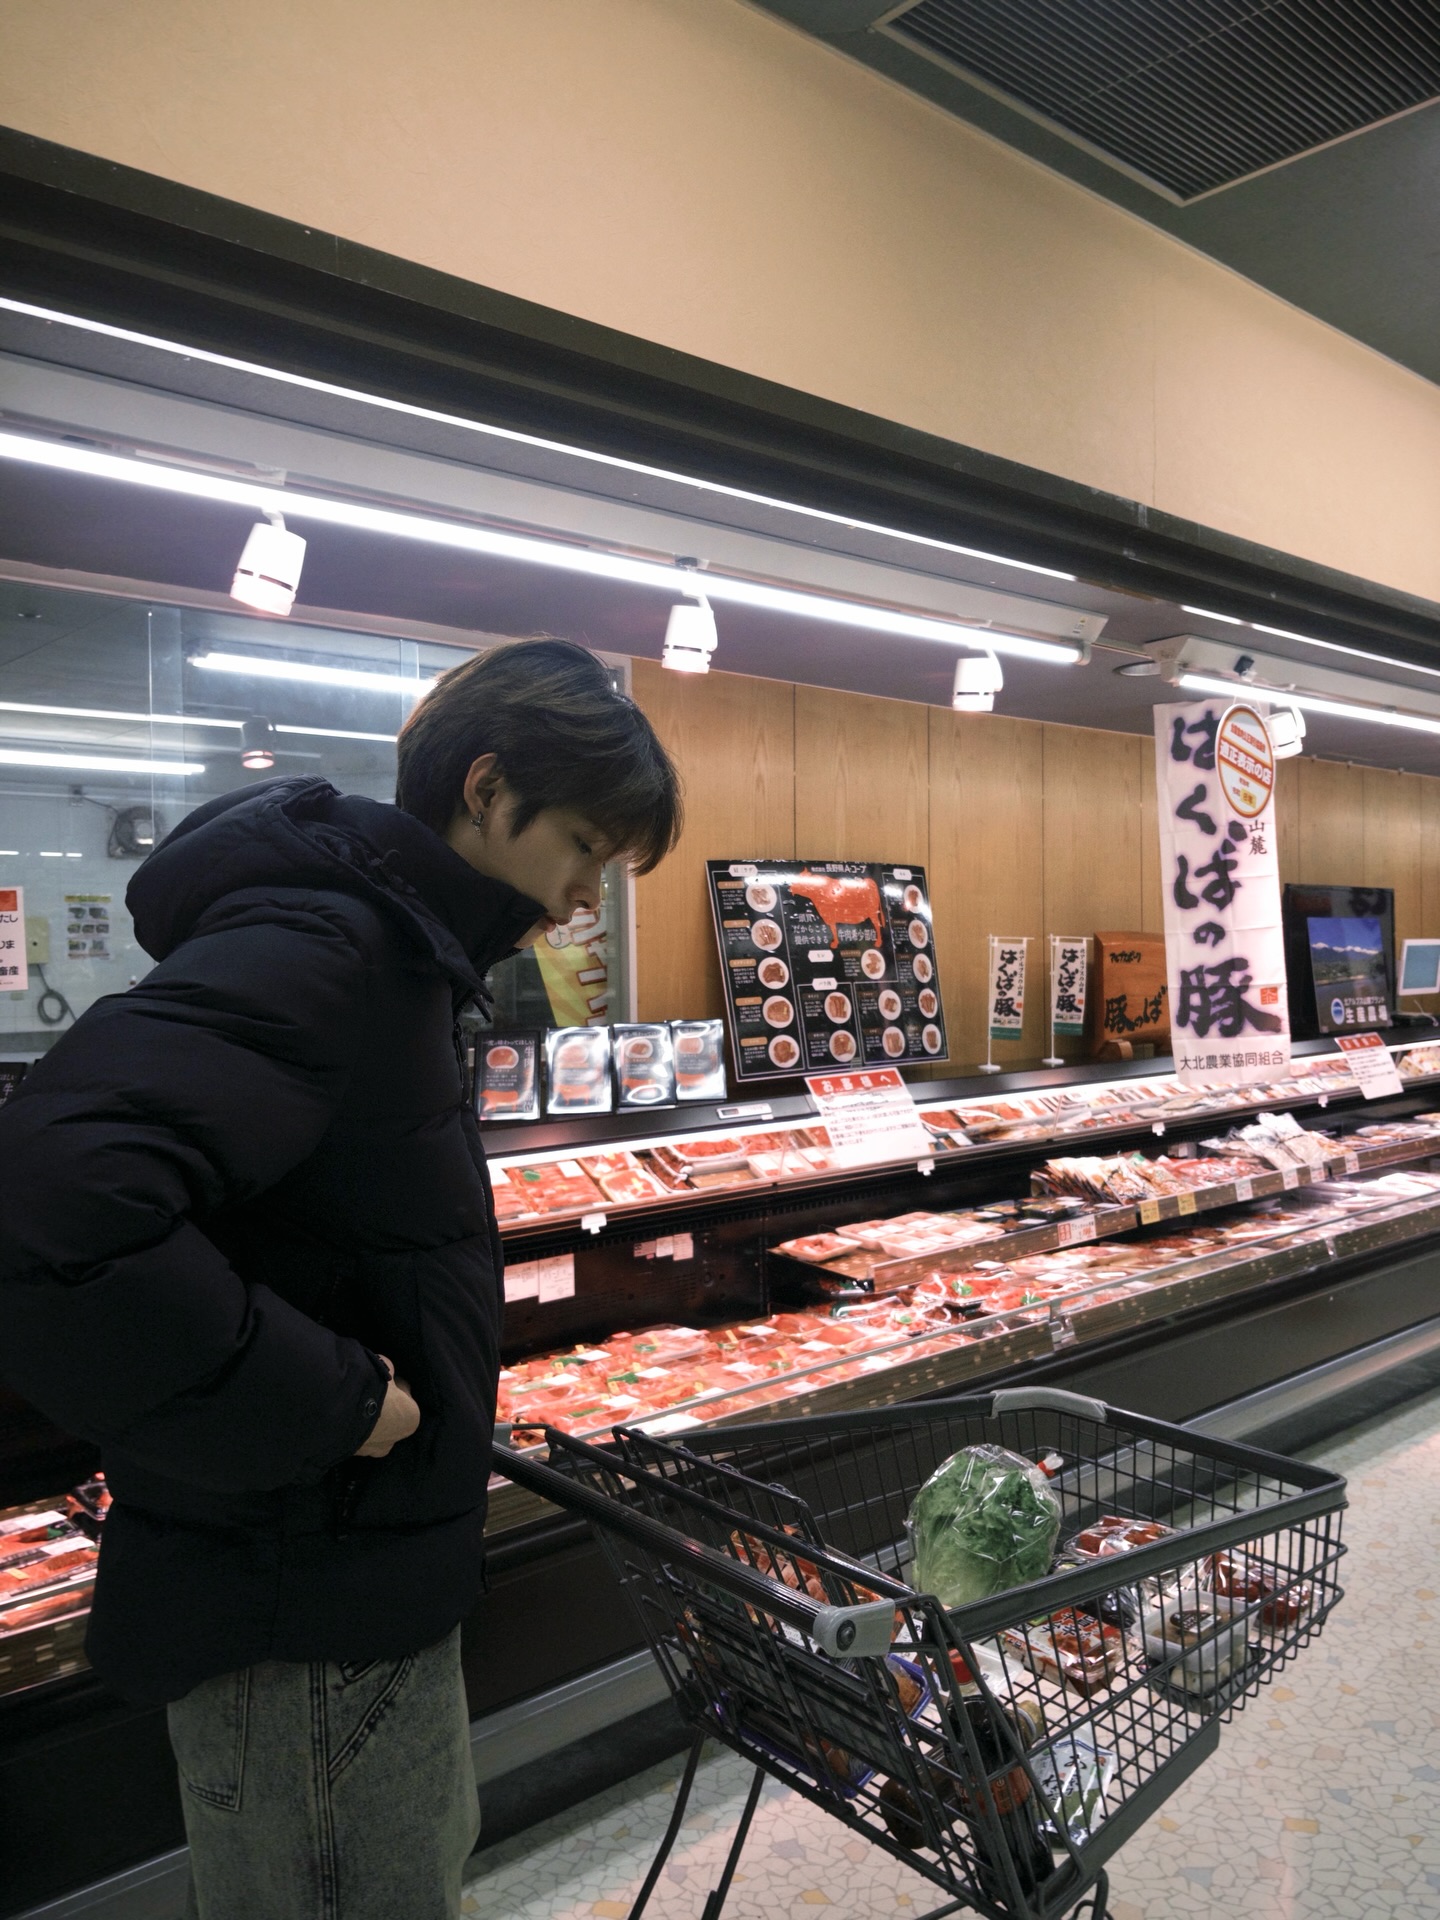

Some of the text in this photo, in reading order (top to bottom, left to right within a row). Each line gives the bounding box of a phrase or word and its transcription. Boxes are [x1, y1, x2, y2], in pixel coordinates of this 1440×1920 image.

[1220, 739, 1272, 786] 適正表示の店
[792, 925, 827, 934] だからこそ
[794, 936, 829, 945] 提供できる
[994, 949, 1021, 1017] はくばの豚
[1056, 948, 1082, 1012] はくばの豚
[1345, 1005, 1388, 1024] 生産農場
[1180, 1050, 1284, 1071] 大北農業協同組合
